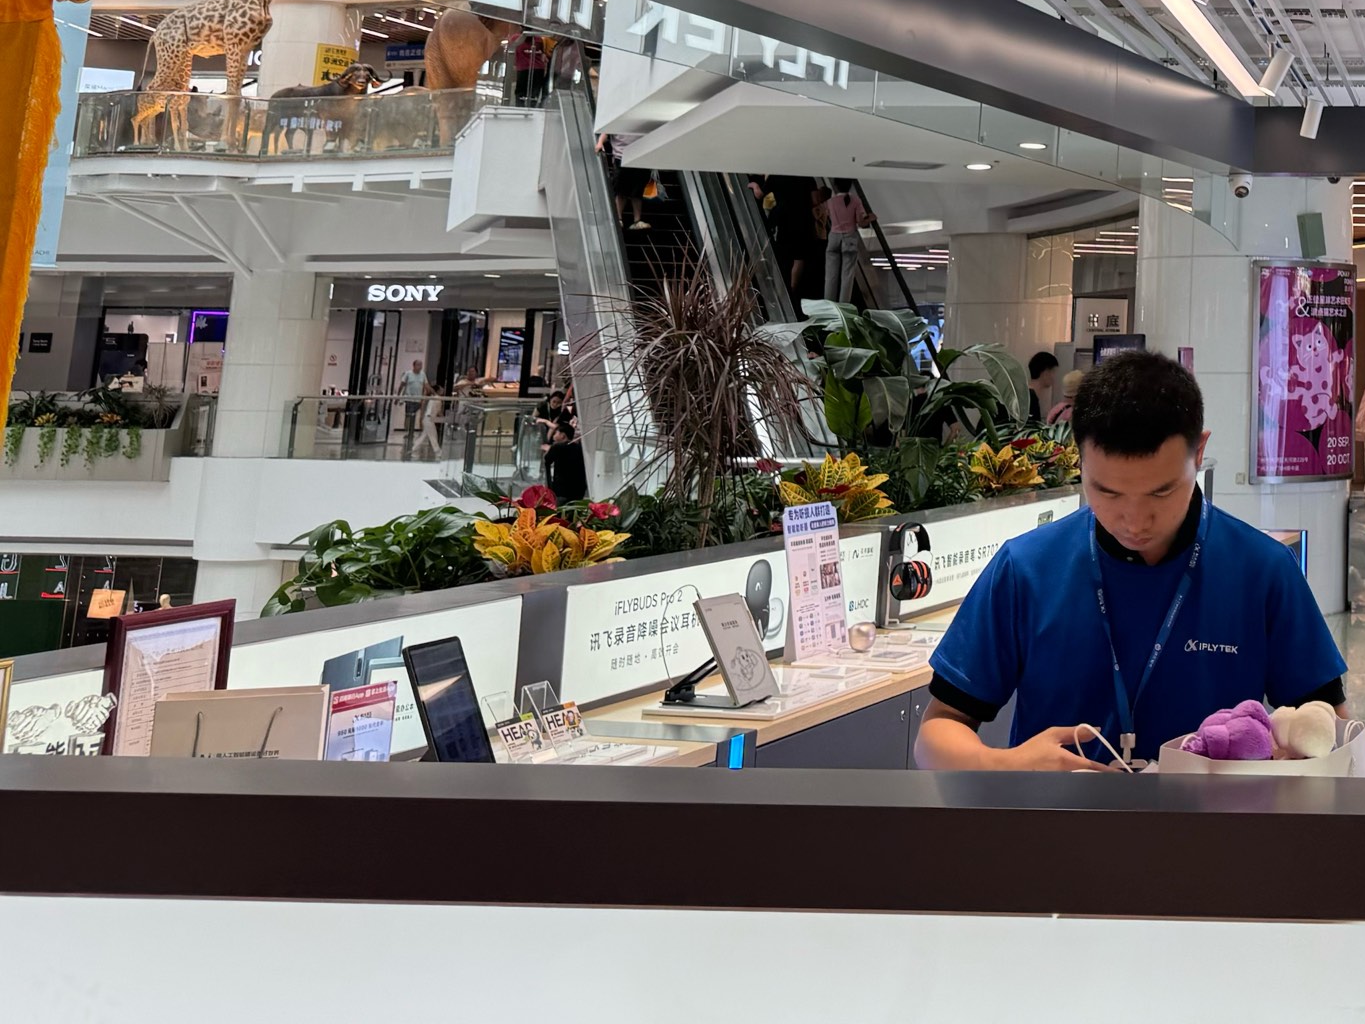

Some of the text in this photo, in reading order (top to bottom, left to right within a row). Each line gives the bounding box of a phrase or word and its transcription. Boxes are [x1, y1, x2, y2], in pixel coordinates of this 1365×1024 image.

[367, 284, 444, 302] SONY
[614, 589, 683, 616] iFLYBUDS Pro 2
